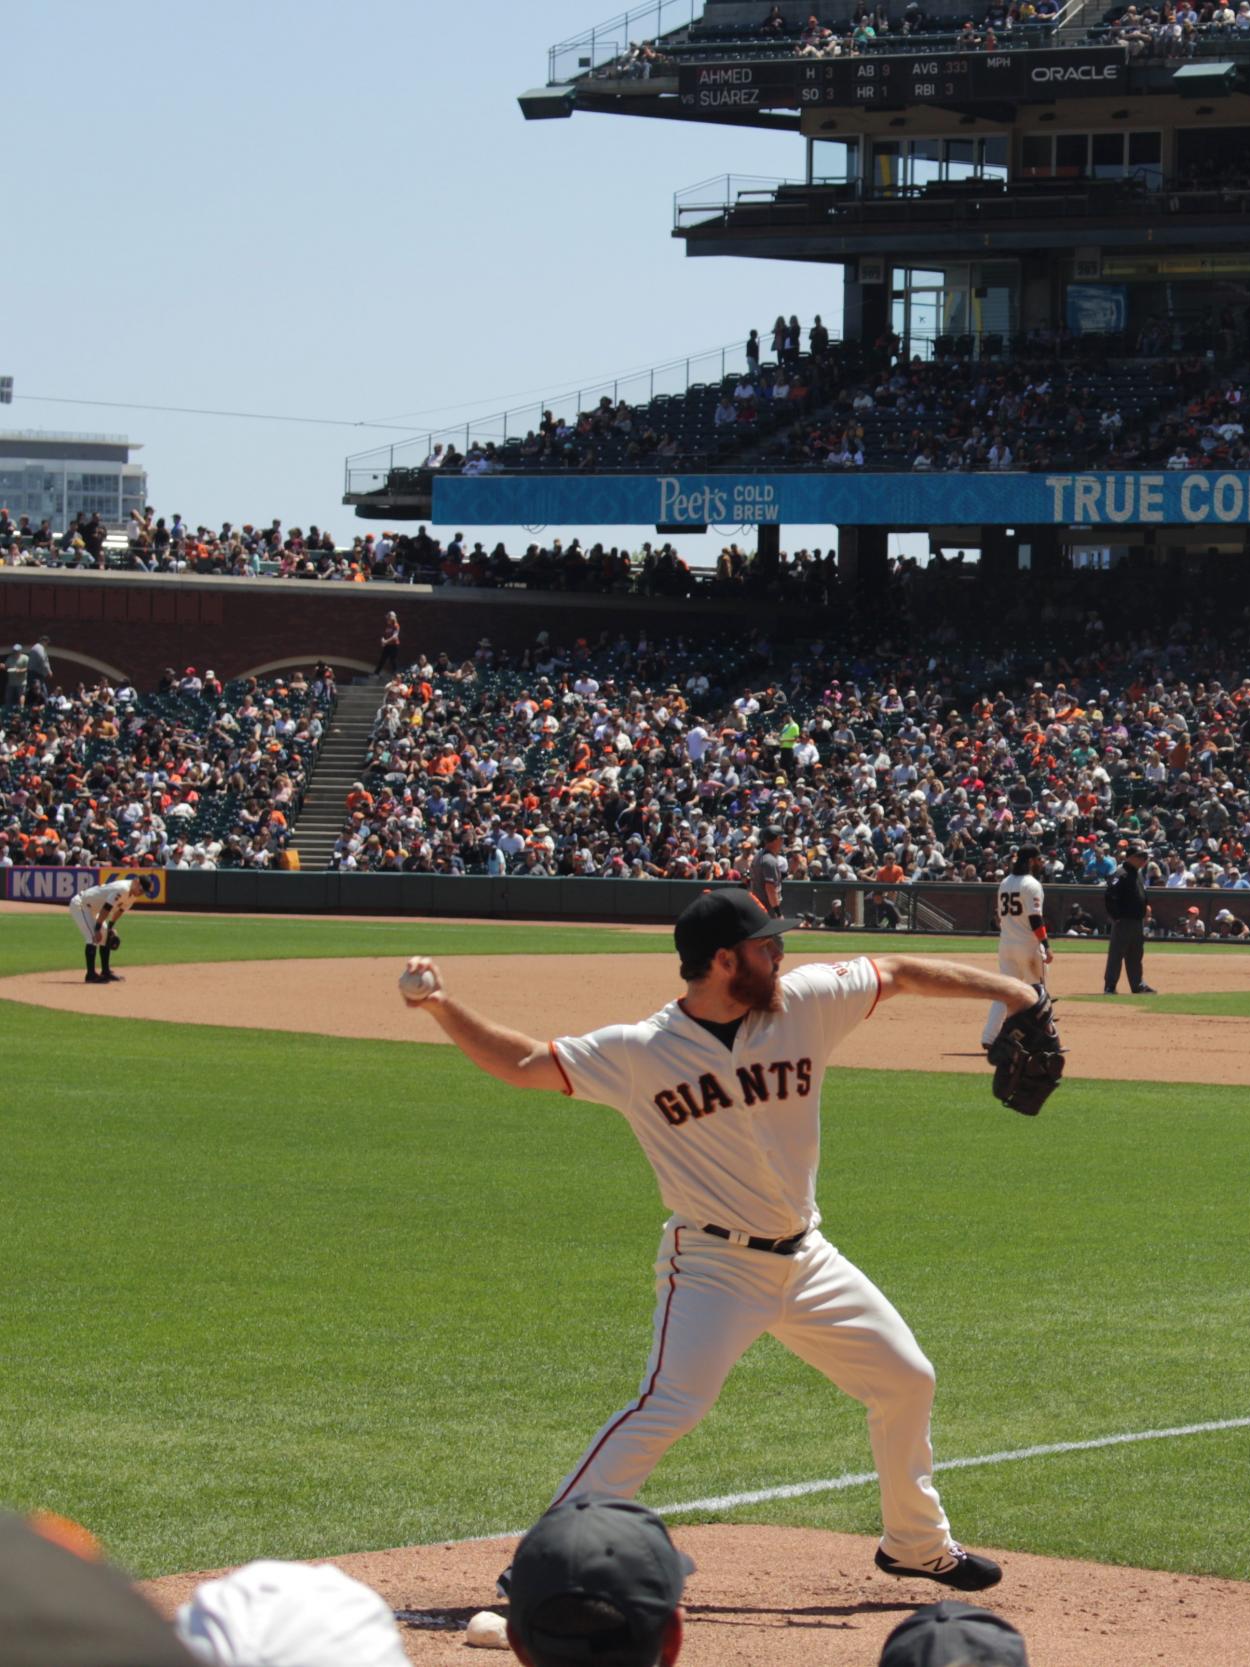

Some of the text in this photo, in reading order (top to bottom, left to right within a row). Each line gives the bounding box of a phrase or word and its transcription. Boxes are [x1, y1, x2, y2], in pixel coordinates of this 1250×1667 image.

[912, 62, 938, 75] AVG
[986, 57, 1011, 68] MPH
[700, 68, 752, 85] AHMED
[806, 67, 816, 80] H
[857, 64, 875, 78] AB
[1031, 65, 1118, 82] ORACLE
[802, 88, 819, 101] SO
[857, 87, 874, 99] HR
[914, 83, 935, 96] RBI
[657, 477, 727, 523] Peet's
[734, 485, 774, 501] COLD
[1046, 475, 1164, 522] TRUE
[733, 504, 779, 520] BREW
[1000, 892, 1023, 916] 35
[654, 1057, 812, 1126] GIANTS
